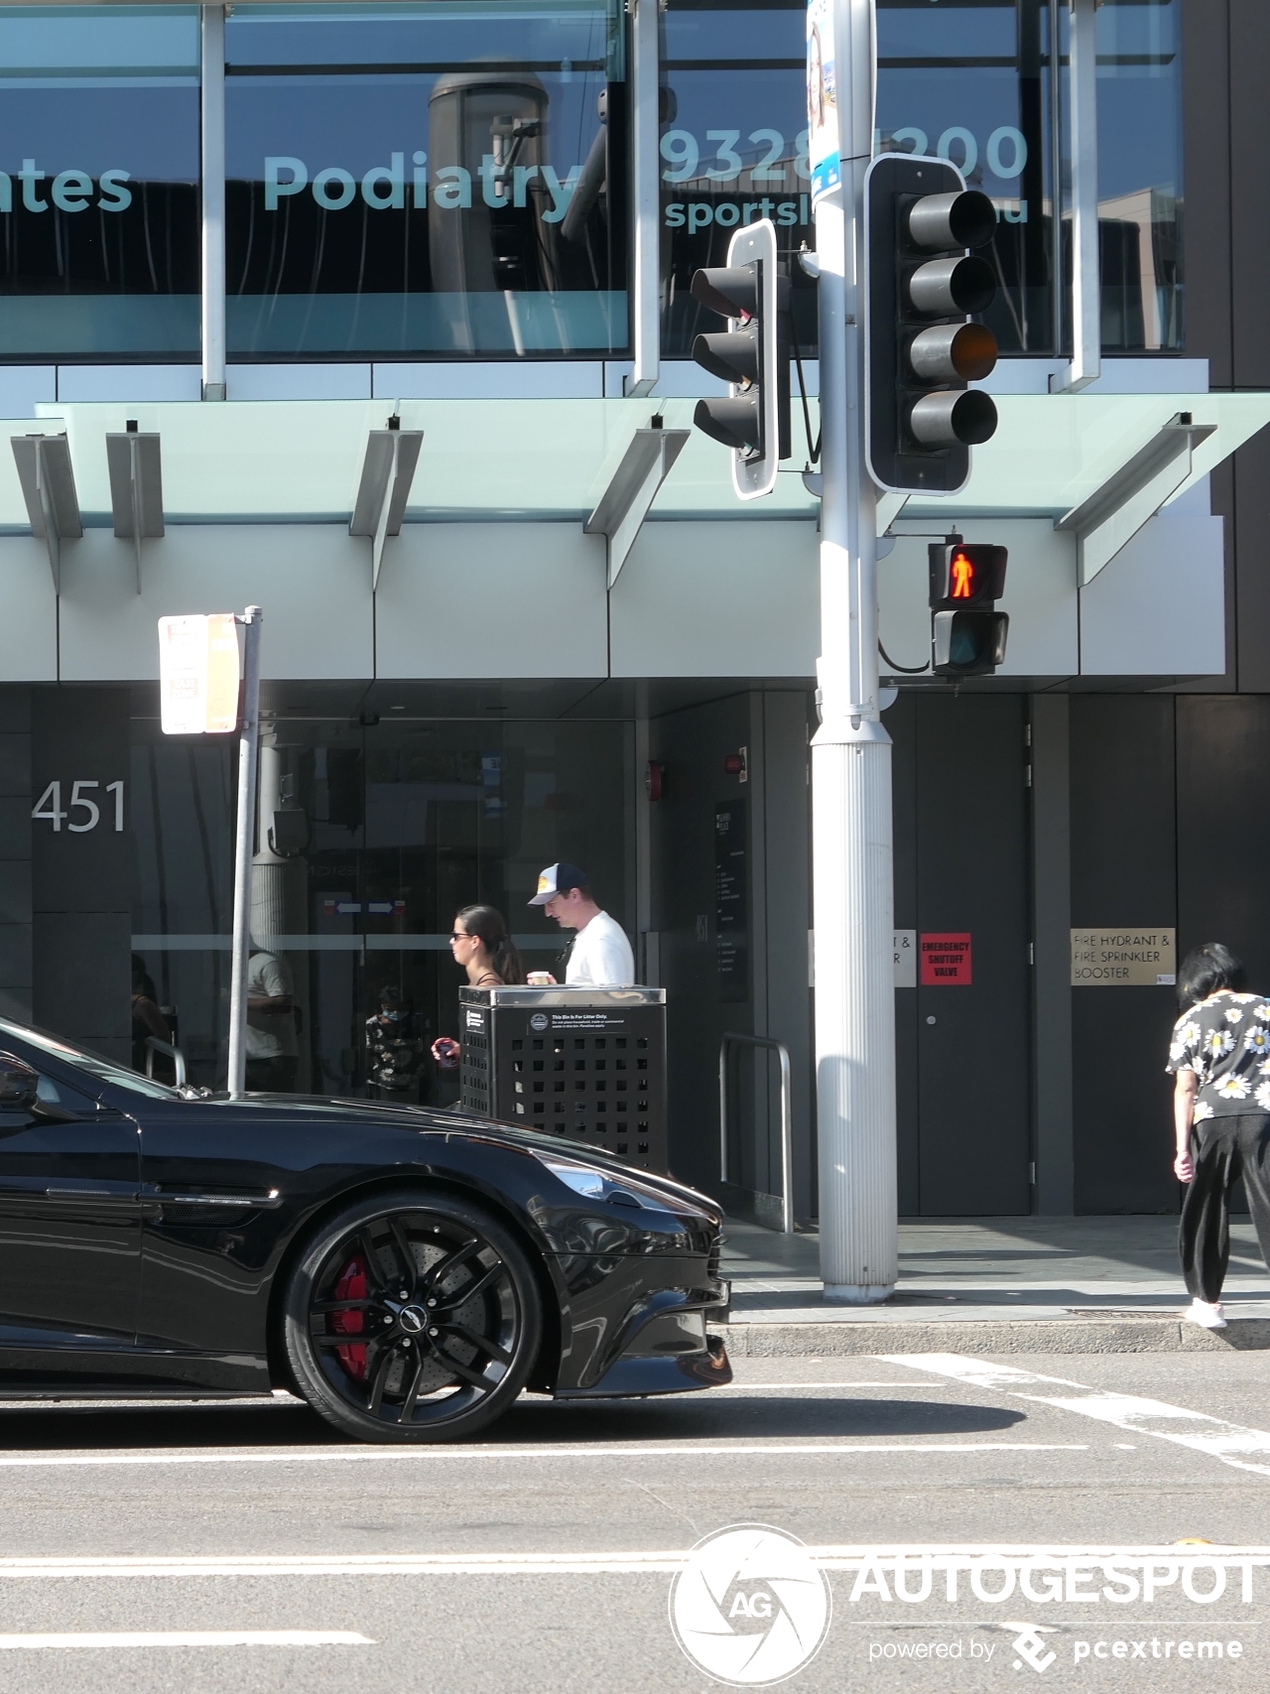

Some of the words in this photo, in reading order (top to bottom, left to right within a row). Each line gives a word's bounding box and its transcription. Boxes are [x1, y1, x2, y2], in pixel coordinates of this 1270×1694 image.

[264, 151, 586, 223] Podiatry
[664, 193, 817, 235] sportsl
[31, 780, 124, 833] 451
[922, 942, 970, 952] EMERGENCY
[1074, 935, 1096, 947] FIRE
[1100, 935, 1158, 947] HYDRANT
[1161, 935, 1170, 947] &
[928, 954, 964, 965] SHUTOFF
[1074, 951, 1096, 963] FIRE
[1101, 951, 1160, 963] SPRINKLER
[934, 967, 958, 977] VALVE
[1074, 967, 1129, 979] BOOSTER
